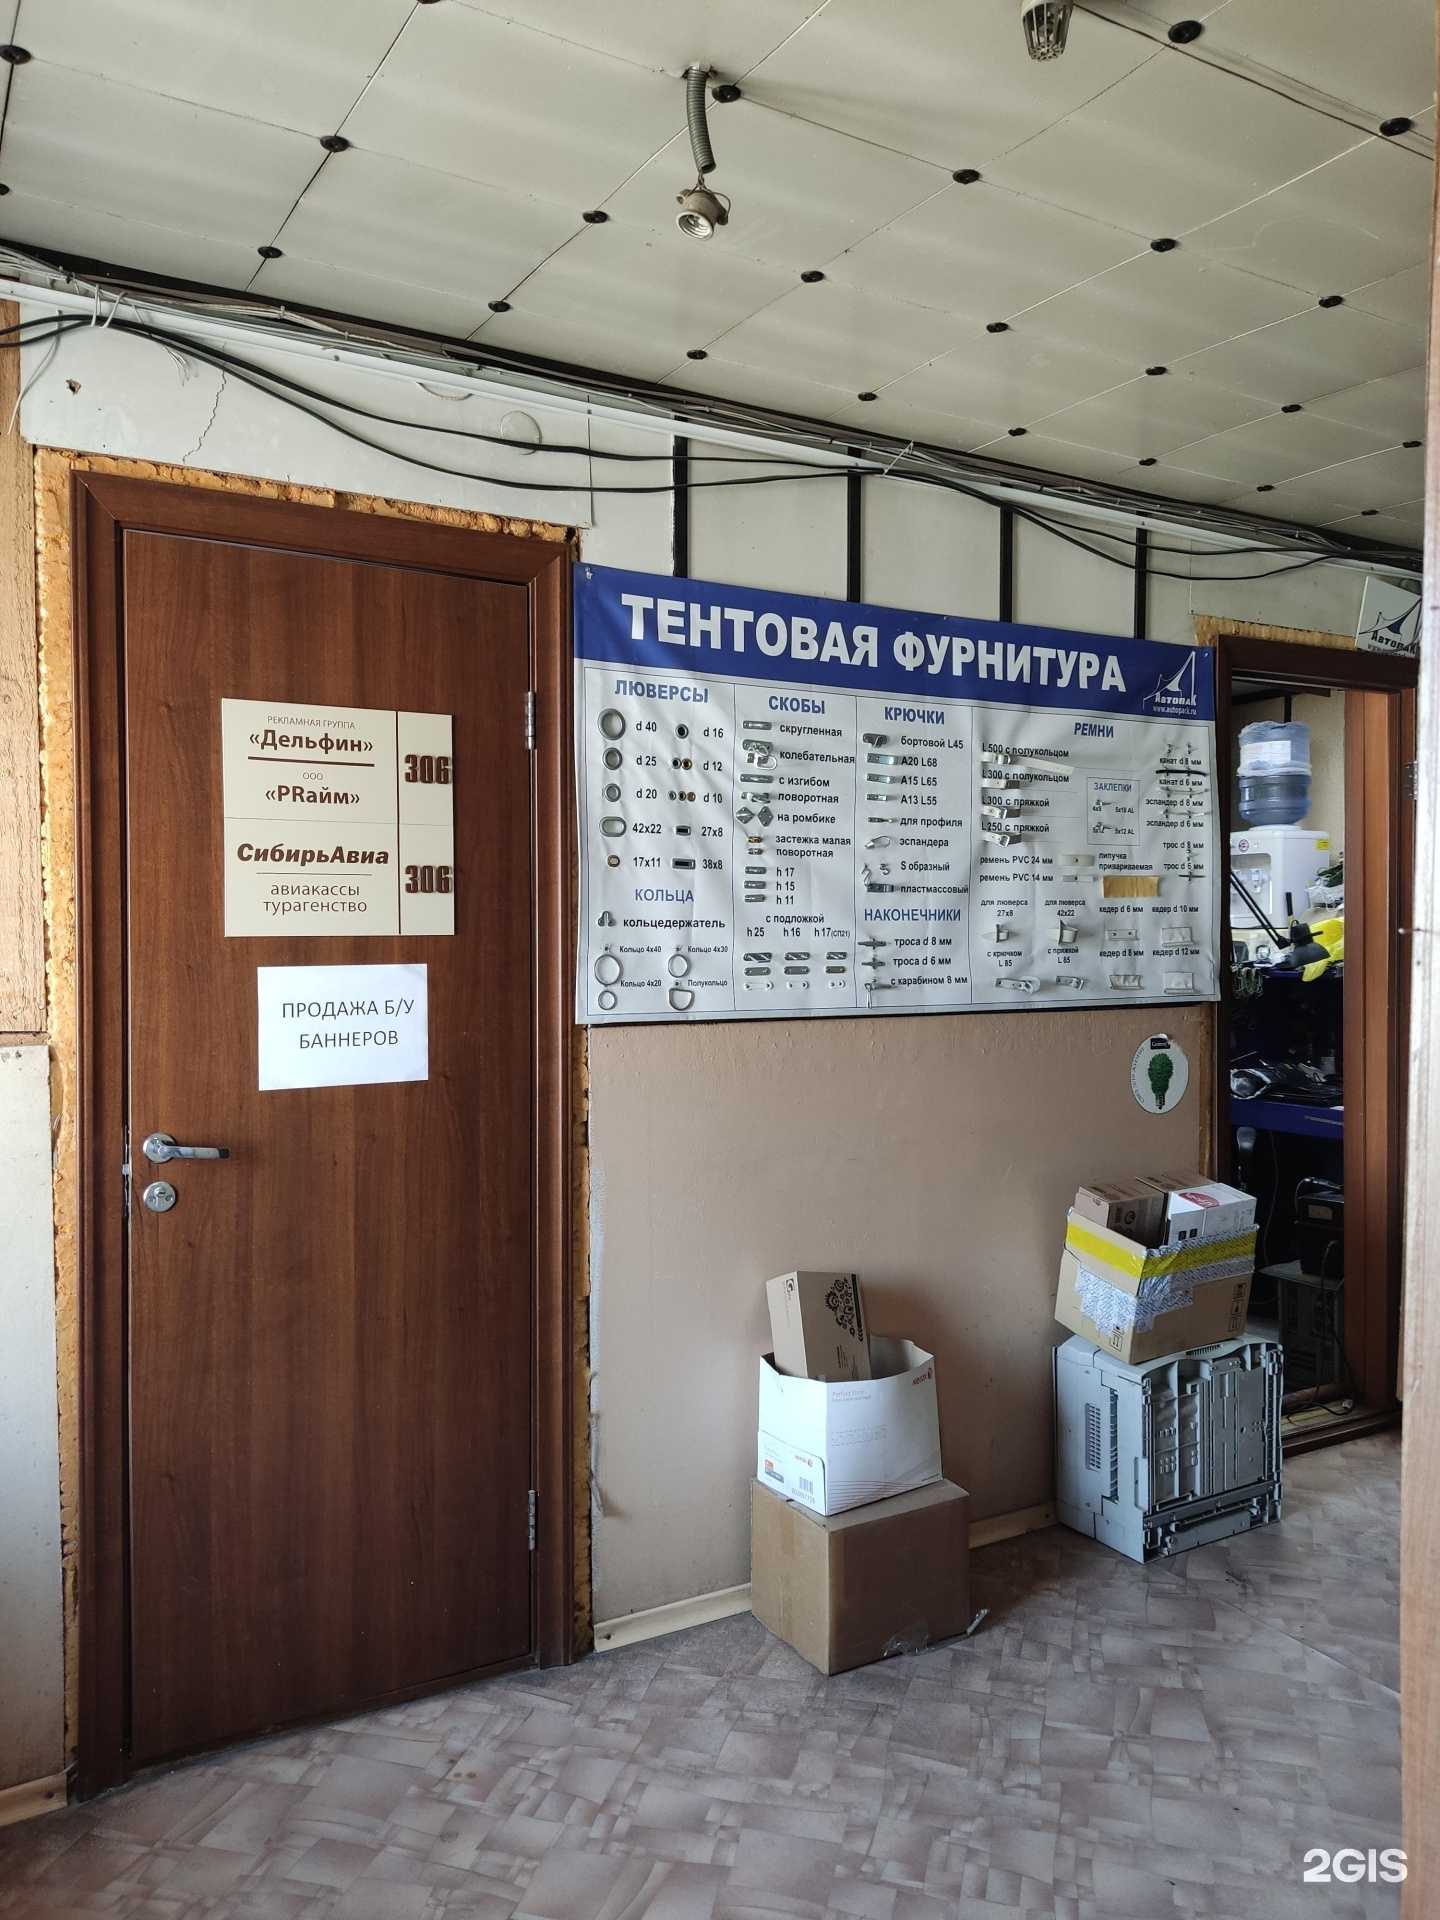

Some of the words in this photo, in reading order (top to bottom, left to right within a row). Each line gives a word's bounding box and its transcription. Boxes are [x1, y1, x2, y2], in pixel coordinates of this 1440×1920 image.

[621, 592, 879, 668] ТЕНТОВАЯ
[893, 630, 1127, 693] ФУРНИТУРА
[614, 679, 710, 704] ЛЮВЕРСЫ
[768, 696, 826, 715] СКОБЫ
[884, 706, 945, 725] КРЮЧКИ
[267, 716, 321, 727] РЕКЛАМНАЯ
[322, 719, 355, 730] ГРУППА
[635, 719, 643, 733] d
[645, 720, 658, 734] 40
[703, 725, 710, 739] d
[712, 726, 724, 739] 16
[779, 723, 843, 738] скругленная
[1074, 721, 1114, 738] РЕМНИ
[249, 730, 373, 754] «Дельфин»
[900, 736, 945, 748] бортовой
[947, 738, 964, 749] L45
[779, 750, 855, 764] колебательная
[1013, 747, 1069, 758] полукольцом
[635, 754, 643, 767] d
[645, 755, 658, 768] 25
[703, 759, 710, 773] d
[712, 760, 723, 773] 12
[921, 757, 938, 768] L68
[302, 771, 323, 780] ООО
[405, 754, 453, 785] 306
[779, 776, 785, 785] с
[788, 775, 830, 787] изгибом
[921, 776, 938, 786] L65
[1013, 773, 1069, 782] полукольцом
[1094, 783, 1132, 792] ЗАКЛЕПКИ
[635, 787, 643, 800] d
[645, 787, 658, 801] 20
[703, 791, 710, 804] d
[712, 792, 723, 805] 10
[778, 792, 840, 805] поворотная
[921, 795, 938, 806] L55
[1014, 798, 1050, 808] пряжкой
[1145, 799, 1178, 807] эспандер
[777, 813, 790, 823] на
[792, 813, 836, 826] ромбике
[900, 816, 918, 827] для
[920, 816, 963, 829] профиля
[1014, 824, 1050, 833] пряжкой
[775, 835, 819, 846] застежка
[822, 836, 851, 846] малая
[899, 837, 949, 849] эспандера
[236, 843, 390, 865] СибирьАвиа
[775, 848, 834, 859] поворотная
[1099, 853, 1128, 861] липучка
[901, 861, 907, 872] S
[909, 860, 951, 872] образный
[980, 856, 1010, 866] ремень
[1012, 855, 1029, 864] PVC
[1030, 855, 1040, 865] 24
[1042, 856, 1054, 864] мм
[776, 866, 783, 876] h
[785, 867, 795, 877] 17
[1099, 864, 1153, 872] привариваемая
[405, 865, 453, 894] 306
[979, 874, 1010, 884] ремень
[1012, 874, 1029, 883] PVC
[1031, 874, 1040, 883] 14
[1042, 874, 1054, 883] мм
[270, 883, 360, 897] авиакассы
[776, 880, 783, 891] h
[785, 881, 796, 892] 15
[901, 883, 969, 895] пластмассовый
[634, 888, 695, 903] КОЛЬЦА
[776, 894, 783, 905] h
[785, 895, 795, 905] 11
[263, 900, 368, 915] турагенство
[981, 899, 994, 907] для
[997, 899, 1029, 908] люверса
[1045, 899, 1057, 907] для
[1058, 899, 1086, 908] люверса
[774, 914, 824, 924] подложкой
[863, 908, 962, 922] НАКОНЕЧНИКИ
[623, 916, 726, 930] кольцедержатель
[747, 927, 752, 937] h
[755, 927, 765, 937] 25
[784, 928, 789, 937] h
[791, 928, 800, 937] 16
[814, 928, 819, 937] h
[894, 937, 920, 947] троса
[923, 936, 929, 946] d
[930, 936, 937, 946] 8
[938, 936, 952, 946] мм
[994, 950, 1022, 958] крючком
[1053, 947, 1079, 955] пряжкой
[893, 957, 919, 967] троса
[921, 956, 928, 966] d
[930, 956, 936, 966] 6
[937, 957, 952, 966] мм
[688, 979, 728, 988] Полукольцо
[890, 977, 896, 985] с
[898, 975, 944, 986] карабином
[946, 974, 952, 985] 8
[953, 975, 968, 985] мм
[282, 1000, 379, 1019] ПРОДАЖА
[384, 998, 415, 1017] Б/У
[299, 1030, 399, 1050] БАННЕРОВ
